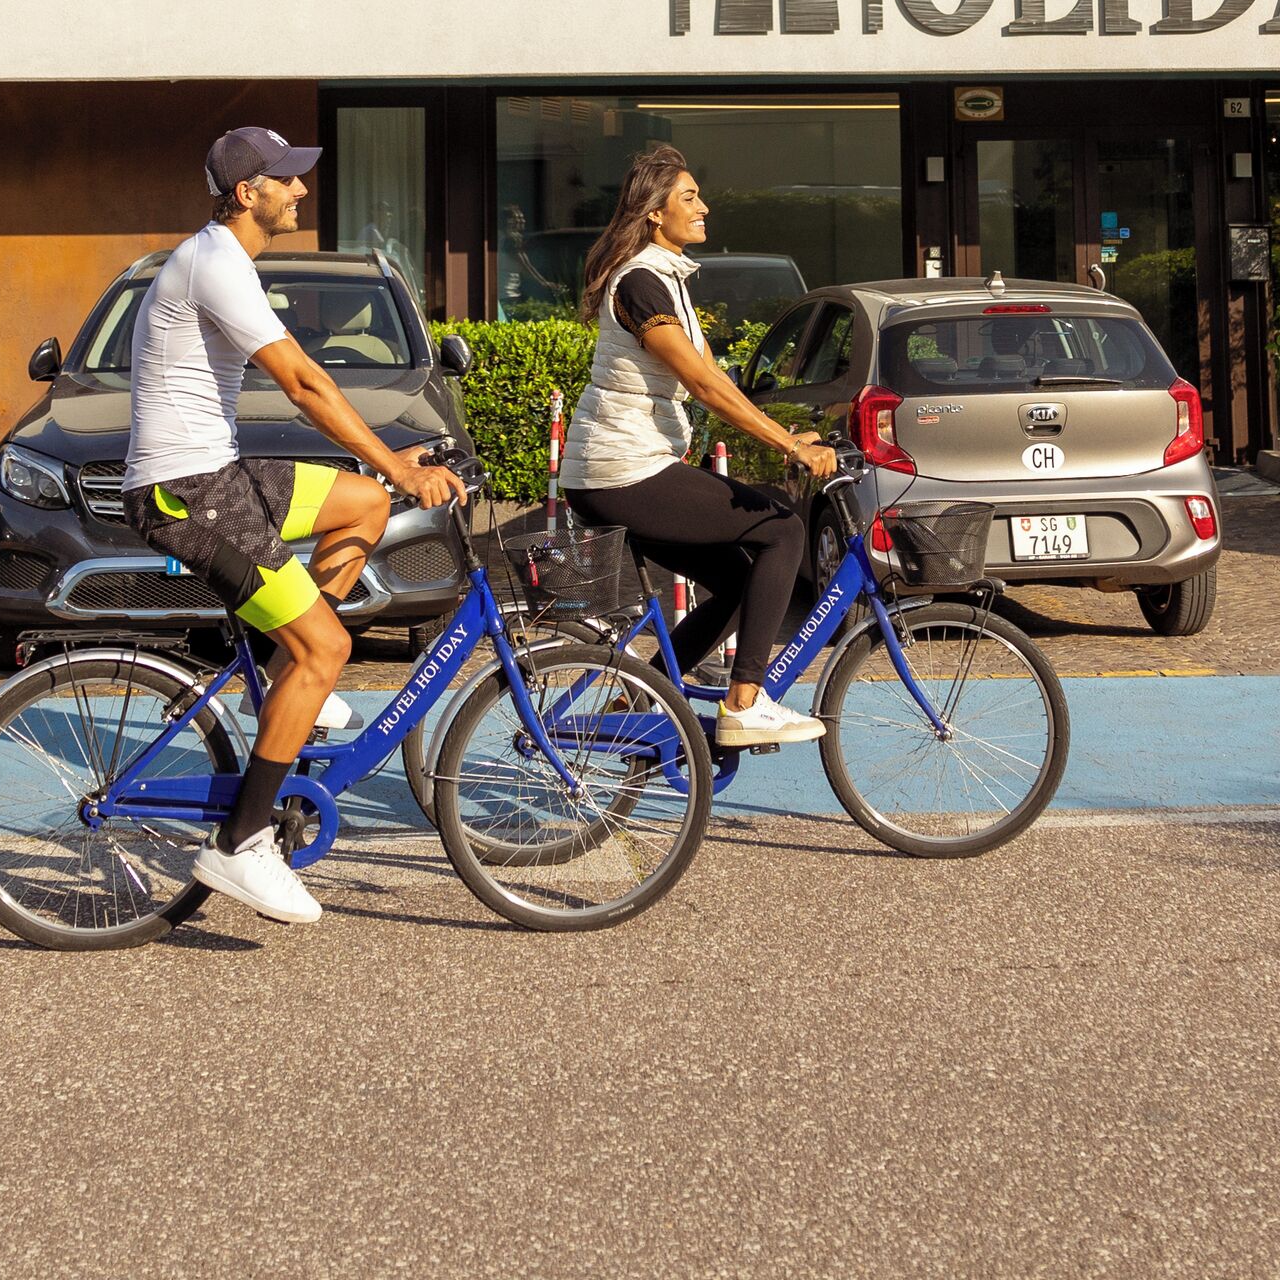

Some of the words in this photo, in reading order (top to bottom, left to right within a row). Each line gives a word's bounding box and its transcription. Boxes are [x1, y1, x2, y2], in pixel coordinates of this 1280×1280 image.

[1231, 102, 1242, 114] 62
[1032, 408, 1056, 420] KIA
[1032, 448, 1055, 469] CH
[1040, 517, 1058, 532] SG
[1029, 535, 1072, 554] 7149
[768, 642, 804, 683] HOTEL
[799, 583, 844, 642] HOLIDAY
